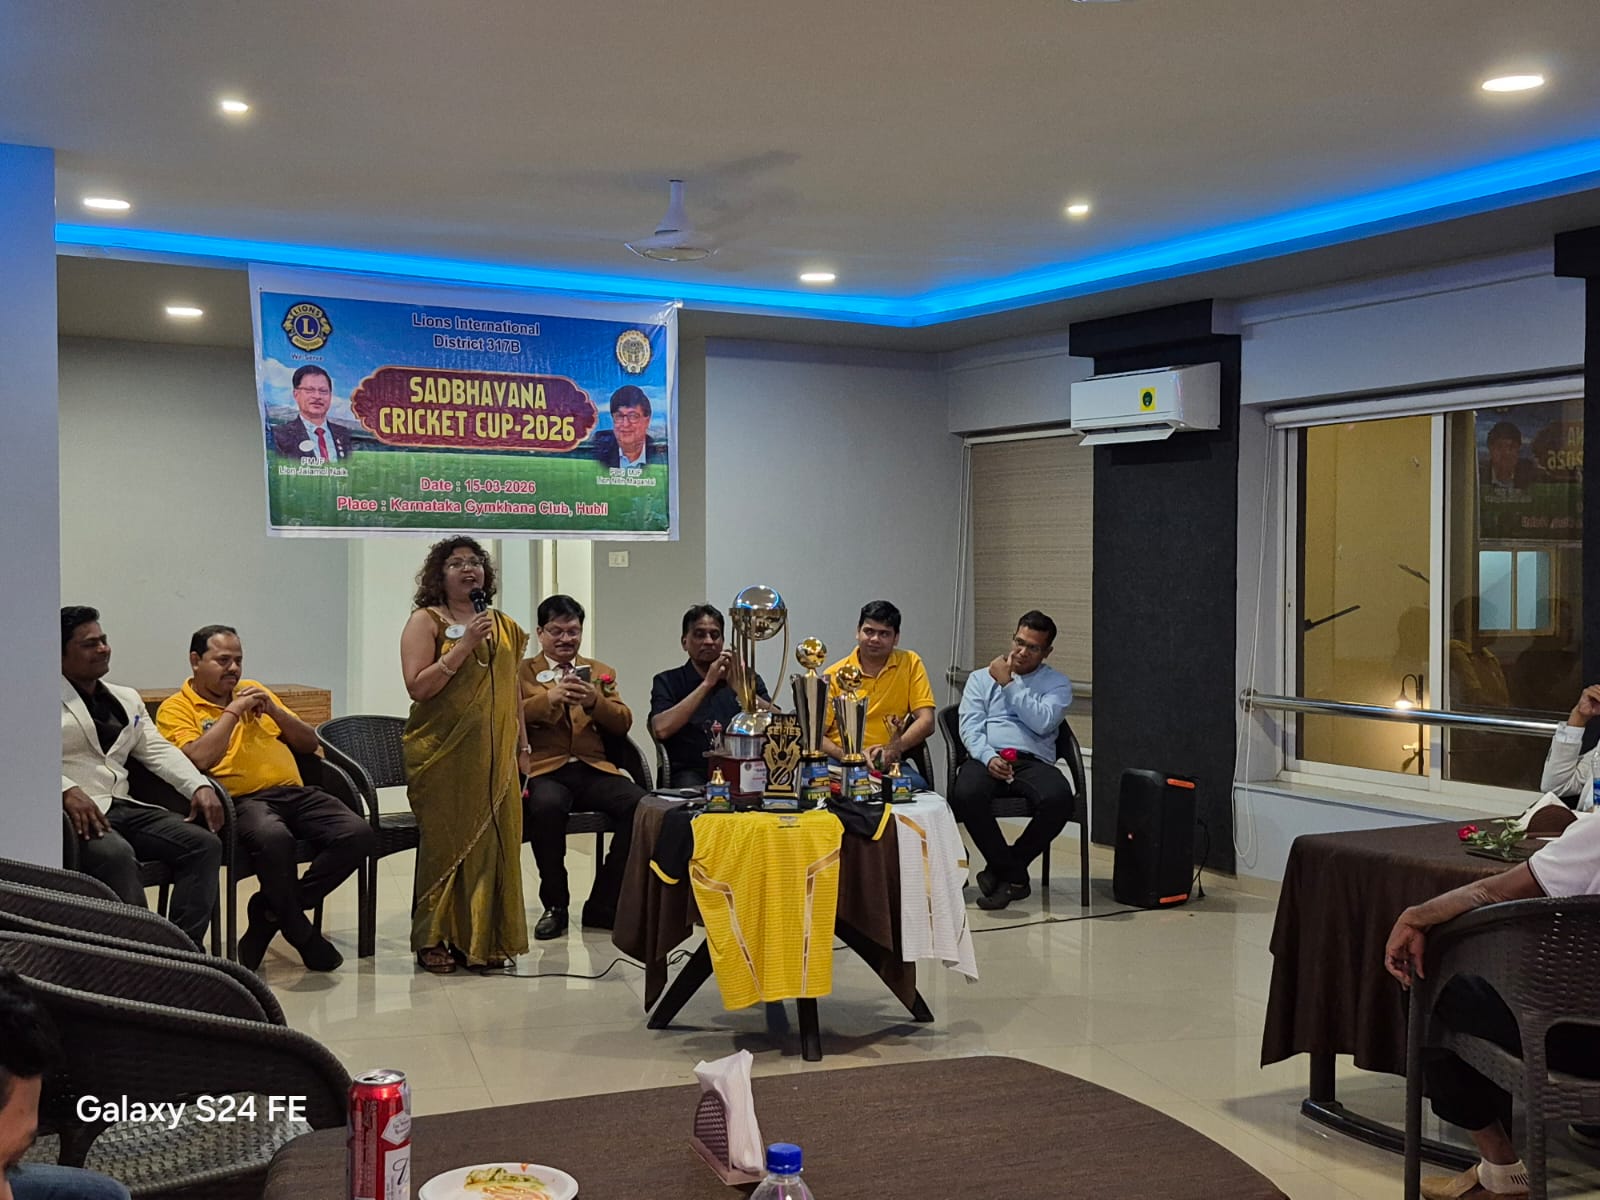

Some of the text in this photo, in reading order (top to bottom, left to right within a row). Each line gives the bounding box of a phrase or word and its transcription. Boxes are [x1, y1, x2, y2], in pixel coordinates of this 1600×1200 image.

[293, 304, 322, 317] LIONS
[412, 313, 541, 336] Lions International
[433, 334, 521, 353] District 317B
[409, 376, 548, 410] SADBHAVANA
[379, 407, 576, 442] CRICKET CUP-2026
[420, 478, 453, 491] Date
[464, 480, 536, 493] 15-03-2026
[336, 496, 378, 512] Place
[390, 497, 462, 513] Karnataka
[464, 499, 537, 516] Gymkhana
[540, 501, 573, 517] Club,
